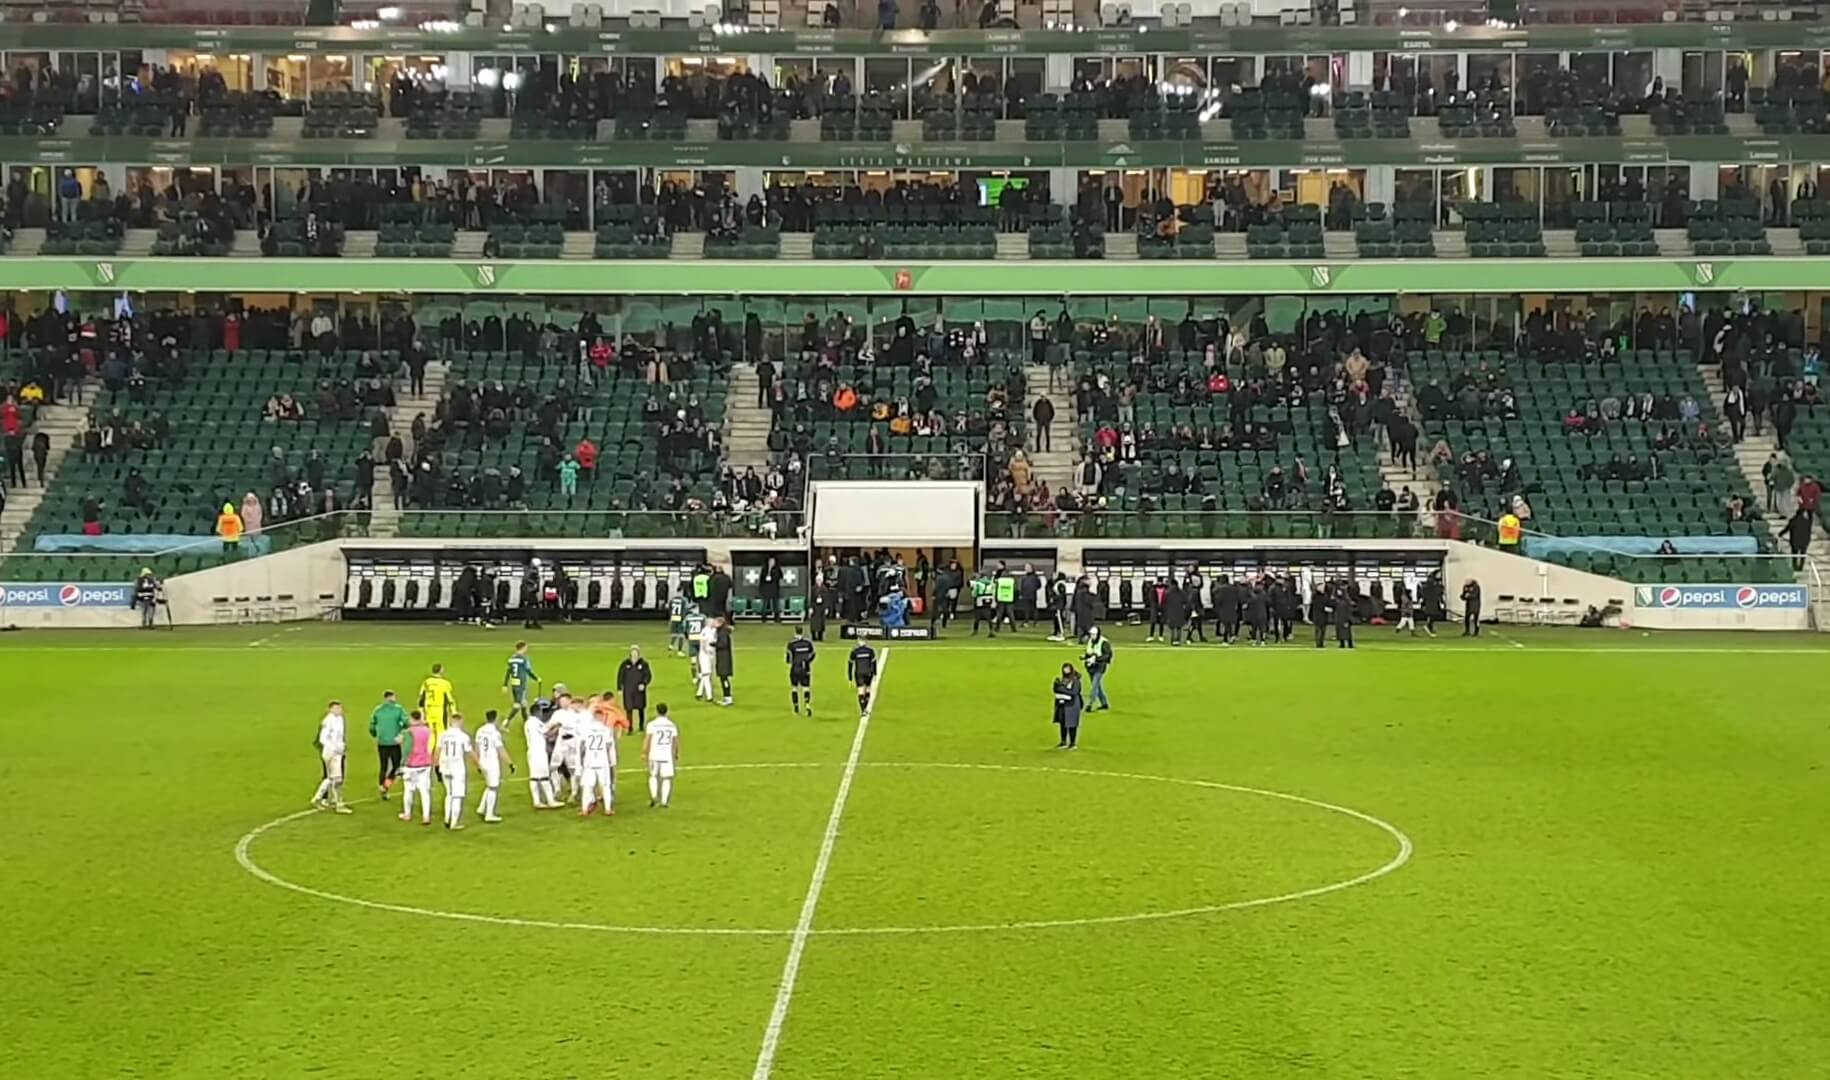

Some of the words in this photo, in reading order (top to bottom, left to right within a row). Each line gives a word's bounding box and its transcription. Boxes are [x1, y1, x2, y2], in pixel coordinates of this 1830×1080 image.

[7, 588, 49, 603] pepsi
[82, 588, 124, 603] pepsi
[1683, 589, 1726, 605] pepsi
[1759, 590, 1801, 605] pepsi
[587, 734, 604, 751] 22
[656, 730, 672, 746] 23
